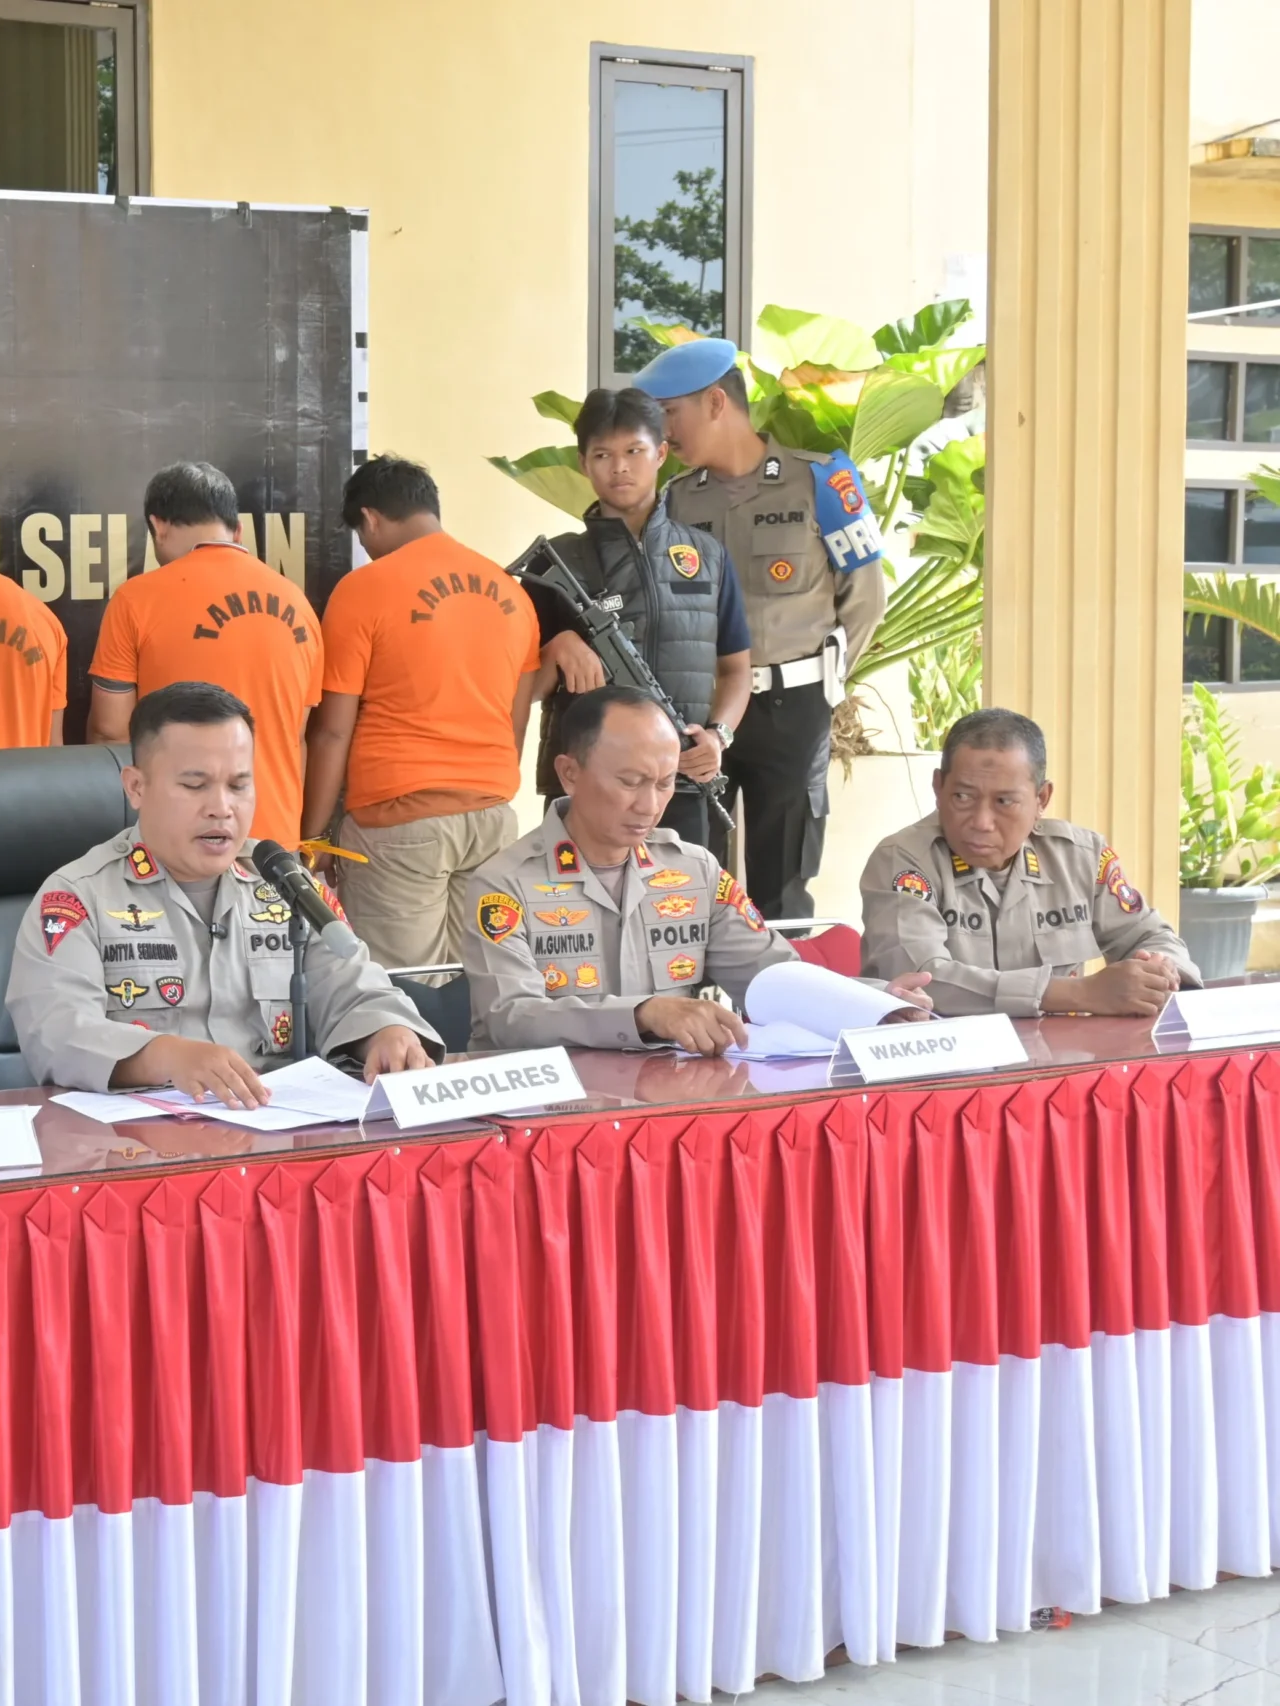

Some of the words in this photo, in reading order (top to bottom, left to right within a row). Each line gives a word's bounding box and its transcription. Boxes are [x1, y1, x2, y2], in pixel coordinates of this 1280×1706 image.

[754, 511, 805, 526] POLRI
[411, 572, 517, 624] TAHANAN
[193, 590, 308, 644] TAHANAN
[940, 908, 983, 931] OKO
[1037, 904, 1088, 929] POLRI
[251, 933, 293, 952] POL
[535, 933, 595, 955] M.GUNTUR.P
[650, 923, 706, 947] POLRI
[102, 943, 135, 962] ADITYA
[412, 1064, 560, 1105] KAPOLRES
